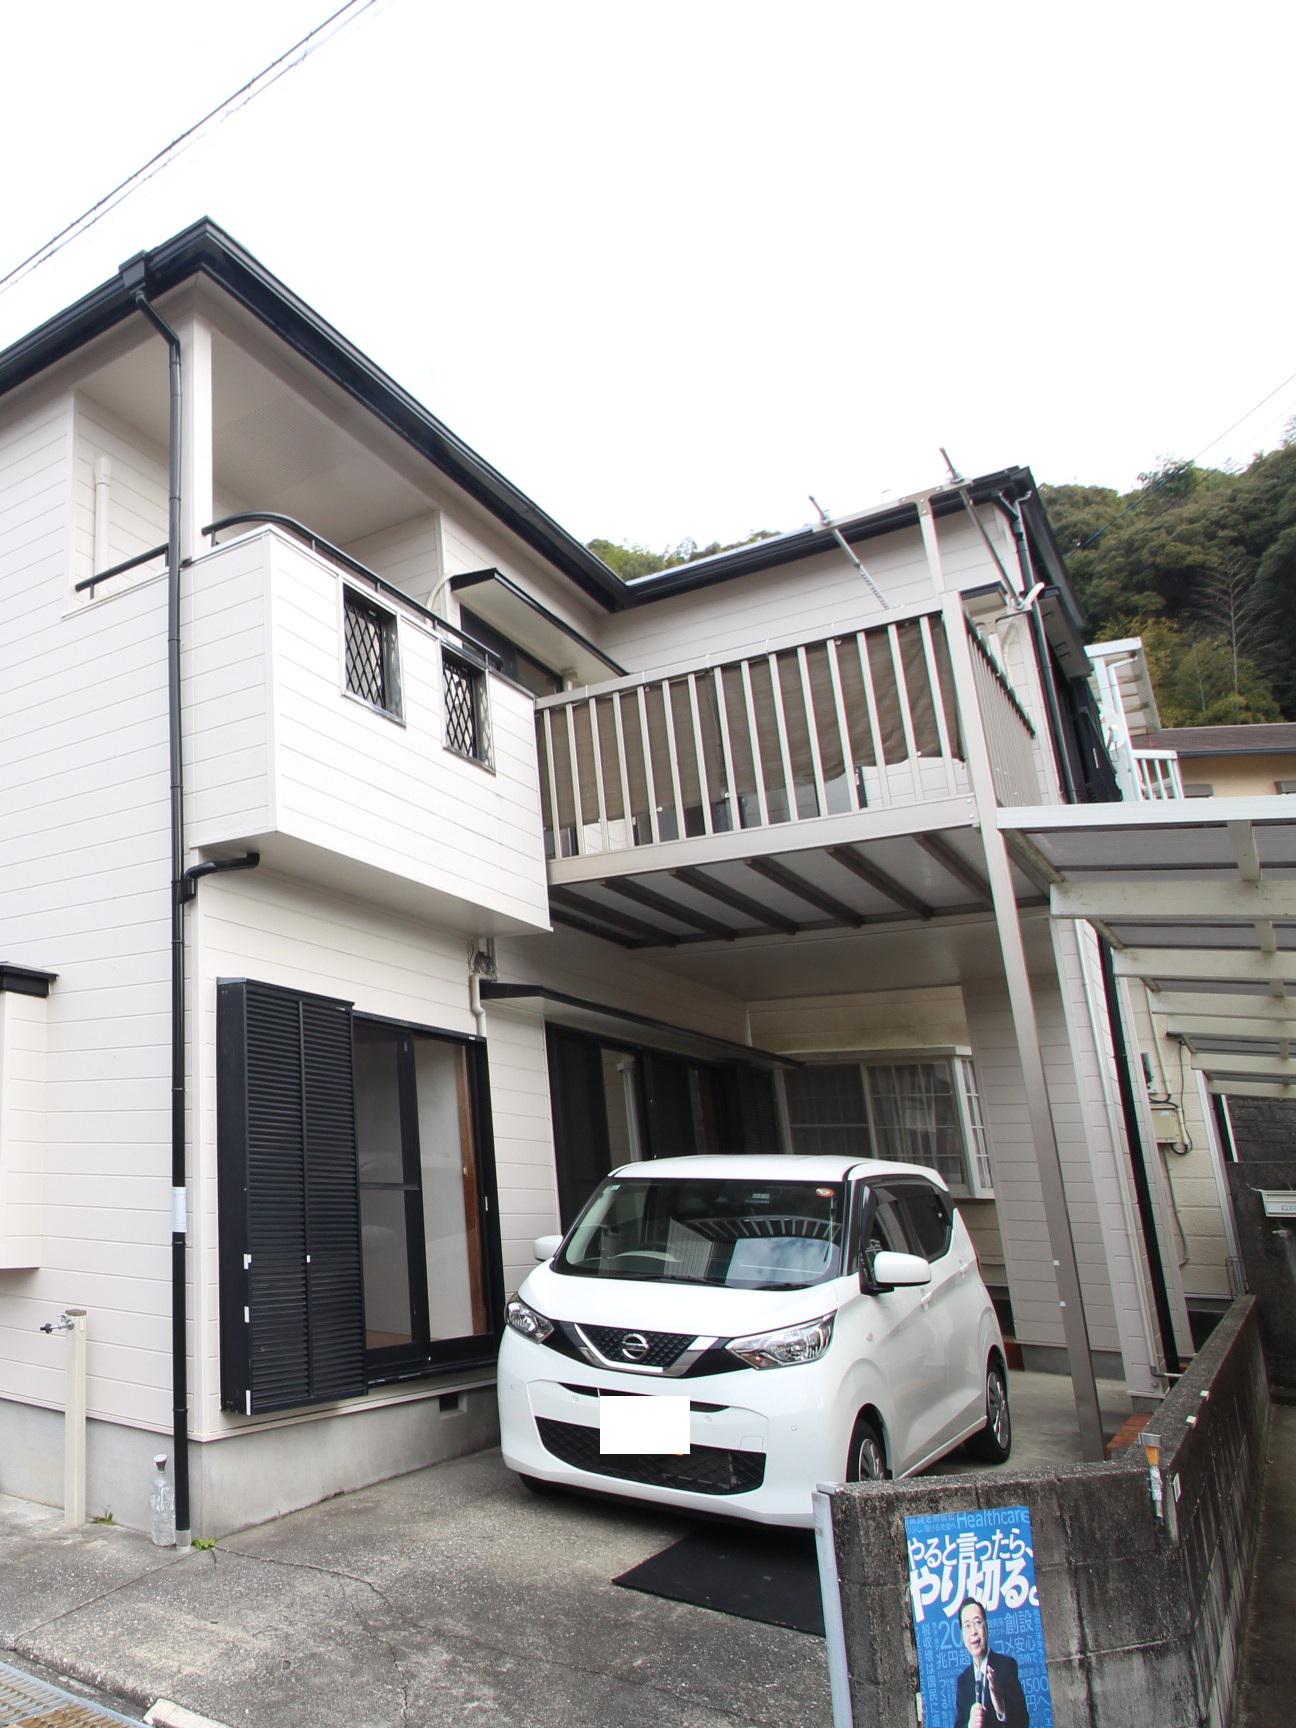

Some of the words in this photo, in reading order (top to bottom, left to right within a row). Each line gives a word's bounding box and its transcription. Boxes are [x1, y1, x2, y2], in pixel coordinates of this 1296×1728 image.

[956, 1509, 1030, 1529] Healthcare
[907, 1528, 1034, 1570] やると言ったら、
[1004, 1610, 1034, 1636] 創設
[936, 1648, 973, 1669] 兆円超
[1021, 1676, 1049, 1695] 1500
